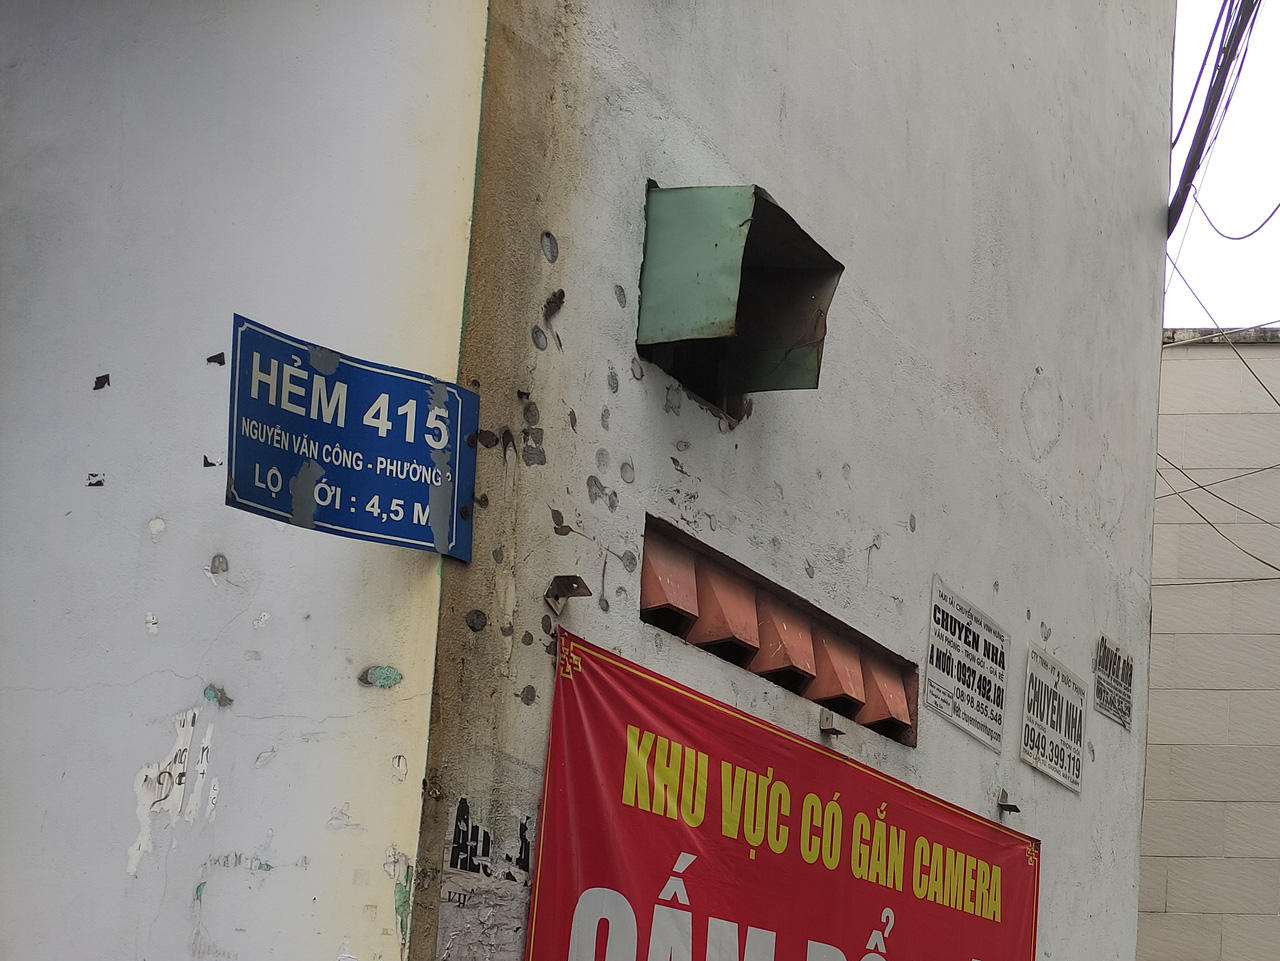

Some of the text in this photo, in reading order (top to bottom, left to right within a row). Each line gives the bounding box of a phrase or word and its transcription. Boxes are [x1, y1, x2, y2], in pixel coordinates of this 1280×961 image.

[250, 351, 450, 450] HẺM 415
[241, 416, 290, 451] NGUYỄN
[293, 433, 319, 460] VĂN
[322, 443, 364, 471] CÔNG
[376, 455, 442, 487] PHƯỜNG
[254, 463, 283, 498] LỘ
[365, 495, 405, 523] 4,5
[983, 637, 1006, 671] NHÀ
[1023, 723, 1081, 779] 0949.399.119
[1064, 698, 1082, 748] NHÀ
[622, 724, 1002, 923] KHU VỰC CÓ GẮN CAMERA
